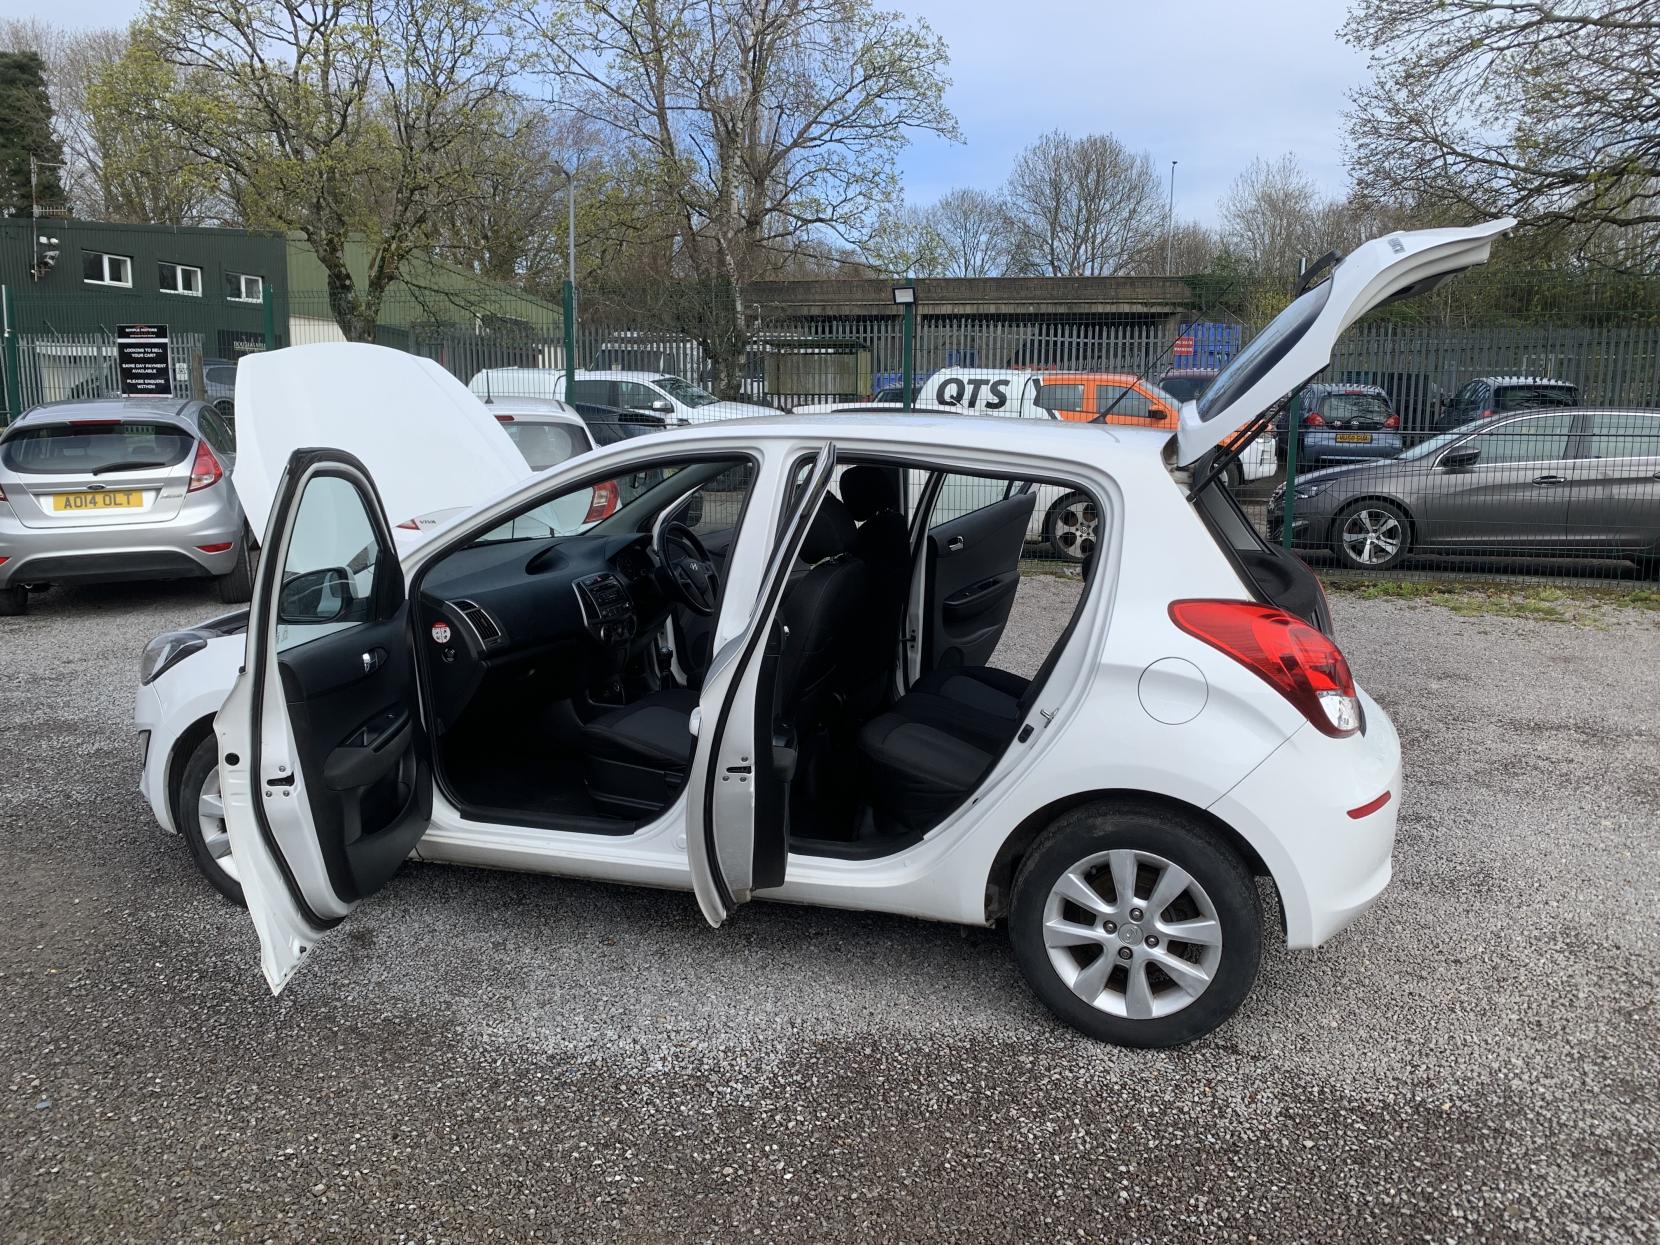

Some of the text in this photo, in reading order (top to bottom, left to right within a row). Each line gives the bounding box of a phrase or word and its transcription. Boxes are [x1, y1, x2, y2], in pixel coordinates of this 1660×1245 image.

[935, 377, 1011, 410] QTS
[64, 493, 133, 509] AO14 OLT
